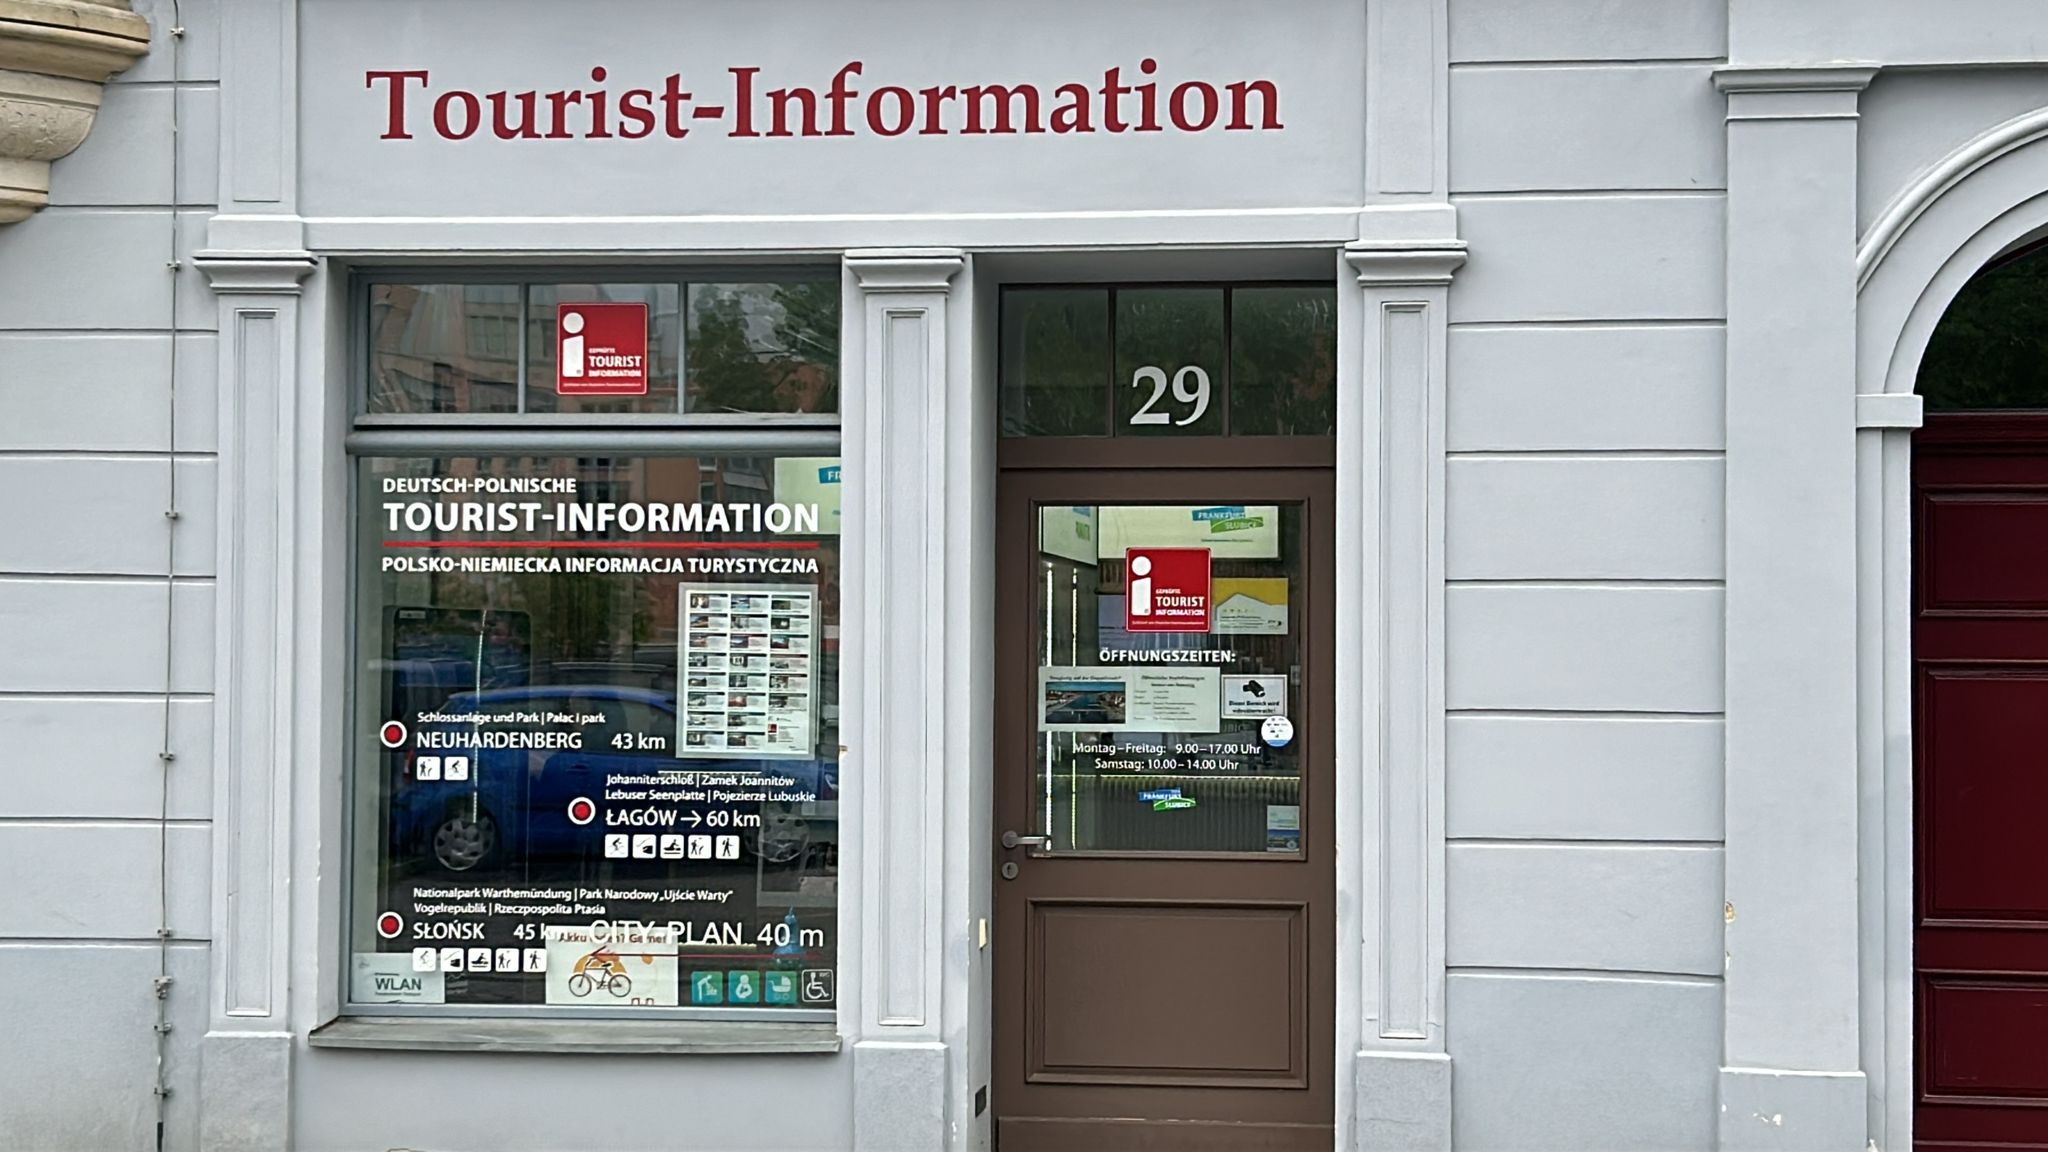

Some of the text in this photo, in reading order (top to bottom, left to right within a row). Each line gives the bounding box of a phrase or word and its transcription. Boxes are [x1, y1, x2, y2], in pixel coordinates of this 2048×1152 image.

[367, 59, 1284, 140] Tourist-Information
[588, 355, 642, 368] TOURIST
[1130, 365, 1211, 426] 29
[383, 478, 577, 493] DEUTSCH-POLNISCHE
[383, 502, 818, 533] TOURIST-INFORMATION
[382, 556, 819, 574] POLSKO-NIEMIECKA INFORMACJA TURYSTYCZNA
[1155, 596, 1205, 607] TOURIST
[1099, 647, 1236, 663] ÖFFNUNGSZEITEN:
[417, 711, 491, 725] Schlossanlage
[493, 712, 514, 723] und
[516, 711, 540, 723] Park
[581, 711, 606, 726] park
[417, 731, 666, 749] NEUHARDENBERG 43 km
[1240, 743, 1262, 755] Uhr
[1094, 758, 1145, 772] Samstag:
[1218, 759, 1240, 770] Uhr
[606, 774, 796, 786] Johanniterschloß Zamek Joannitów
[605, 789, 816, 804] Lebuser Seenplatte Pojezierze Lubuskie
[605, 806, 761, 827] ŁAGÓW 60 km
[413, 887, 480, 900] Nationalpark
[481, 887, 572, 902] Warthemündung
[579, 888, 603, 899] Park
[604, 889, 659, 903] Narodowy
[413, 902, 606, 917] Vogelrepublik Rzeczpospolita Ptasia
[413, 919, 485, 940] SŁOŃSK
[513, 923, 535, 940] 45
[757, 923, 791, 947] 40
[800, 928, 824, 947] m
[374, 977, 422, 991] WLAN
